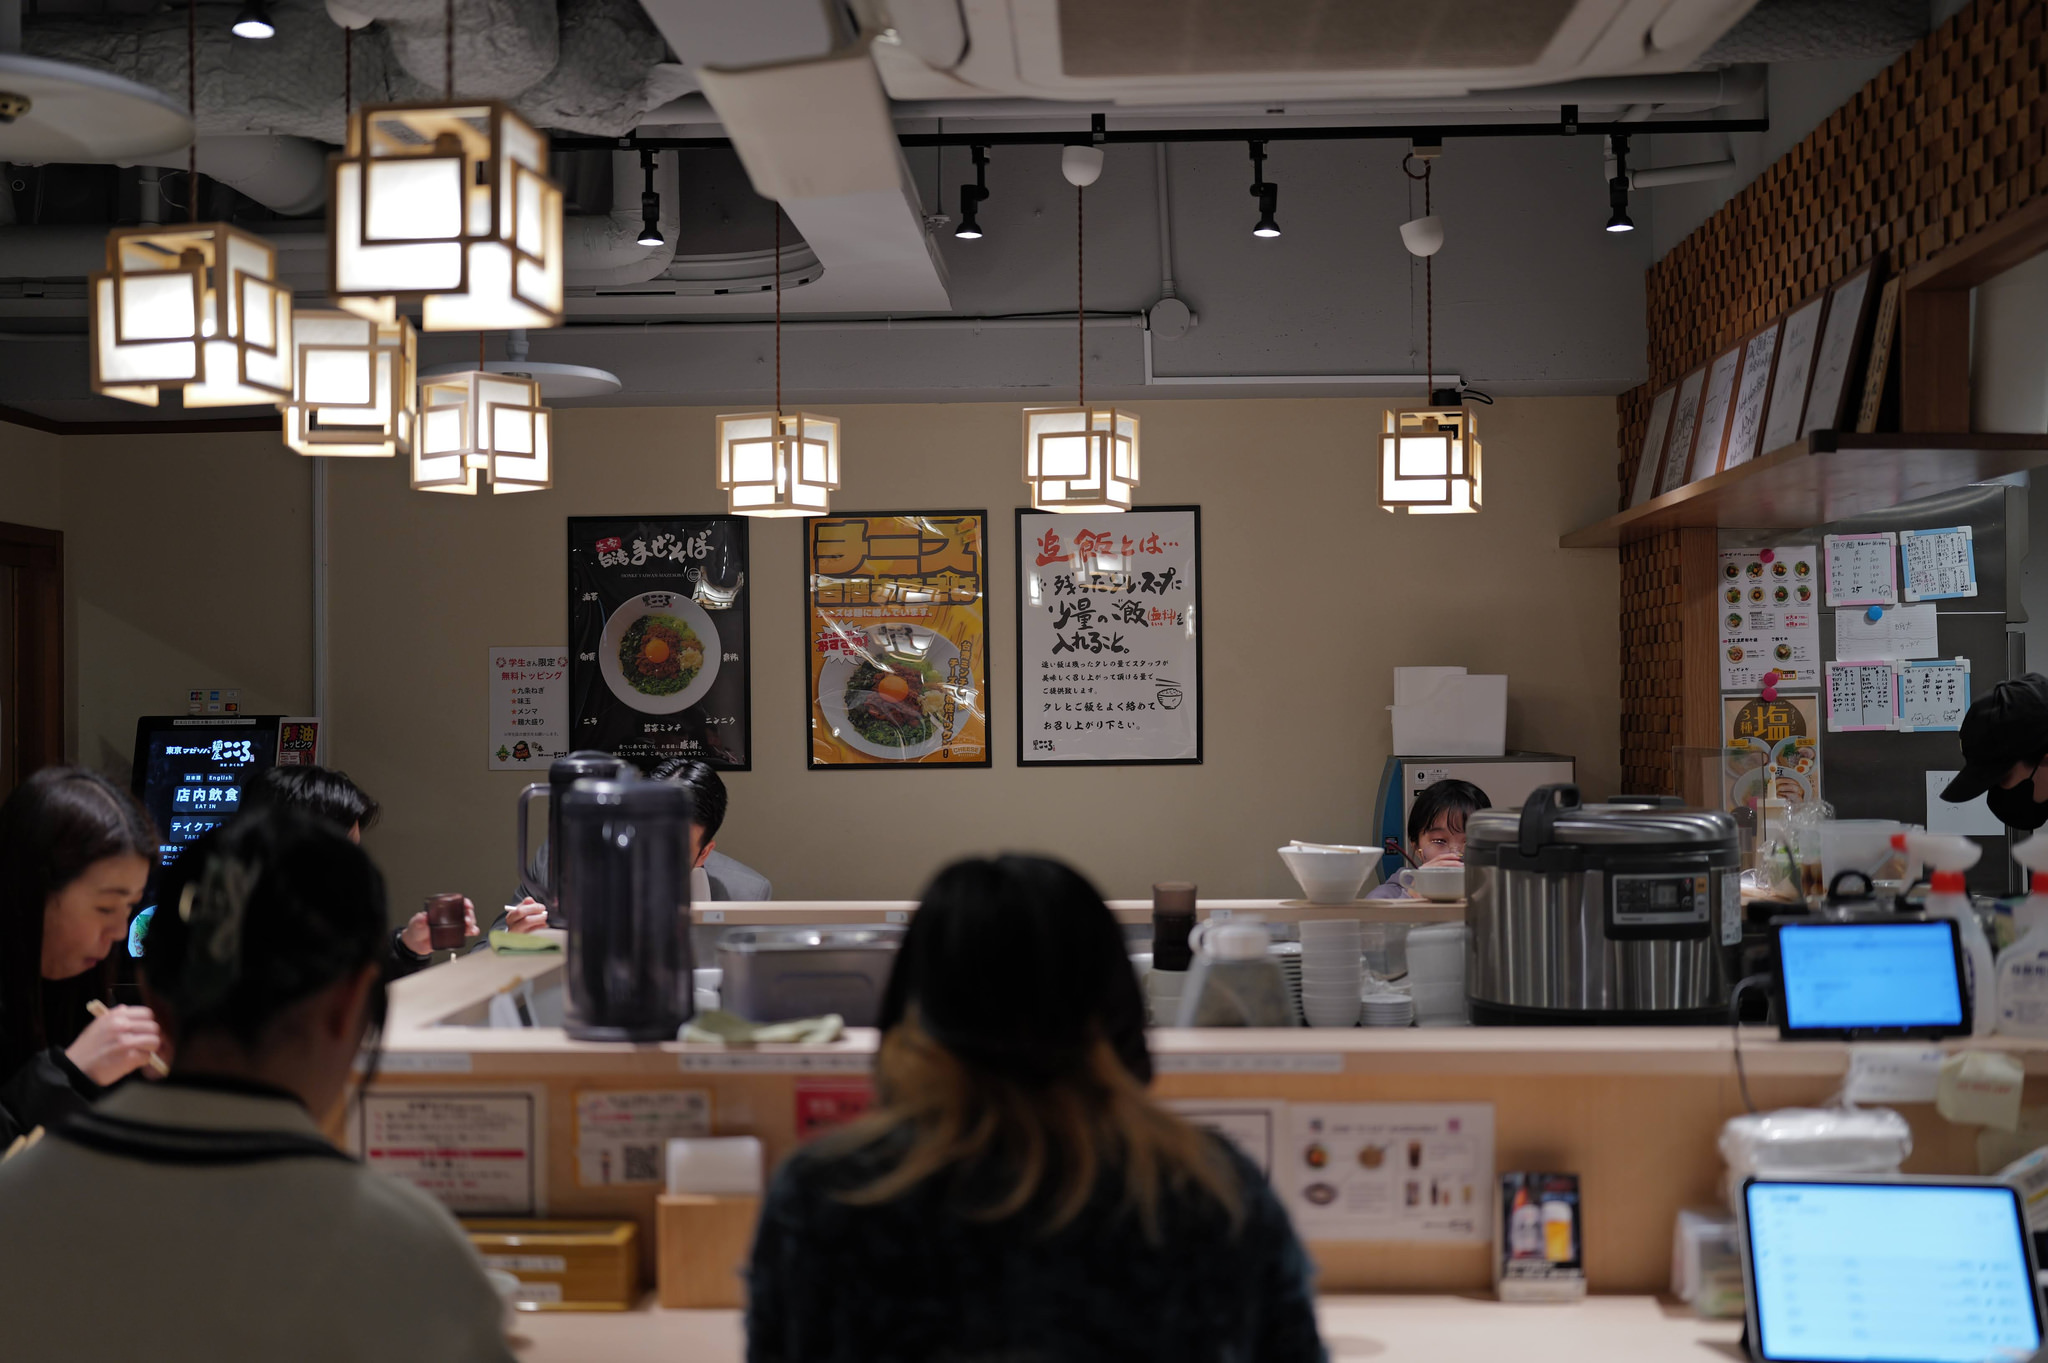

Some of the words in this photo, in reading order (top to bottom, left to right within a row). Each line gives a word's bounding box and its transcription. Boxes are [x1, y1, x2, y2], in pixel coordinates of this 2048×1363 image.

[814, 516, 979, 576] チーズ
[1051, 631, 1130, 655] 入れること。
[508, 658, 556, 667] 学生さん限定
[501, 671, 562, 680] 無料トッピング
[1041, 673, 1154, 682] 美味しく召し上がって頂ける量で
[1043, 701, 1156, 712] タレとご飯をよく絡めて
[583, 717, 598, 725] ニラ
[705, 717, 736, 725] ニンニク
[1043, 720, 1141, 730] お召し上がり下さい。
[1753, 705, 1789, 741] 塩
[283, 739, 313, 749] トッピング
[176, 787, 239, 802] 店内飲食
